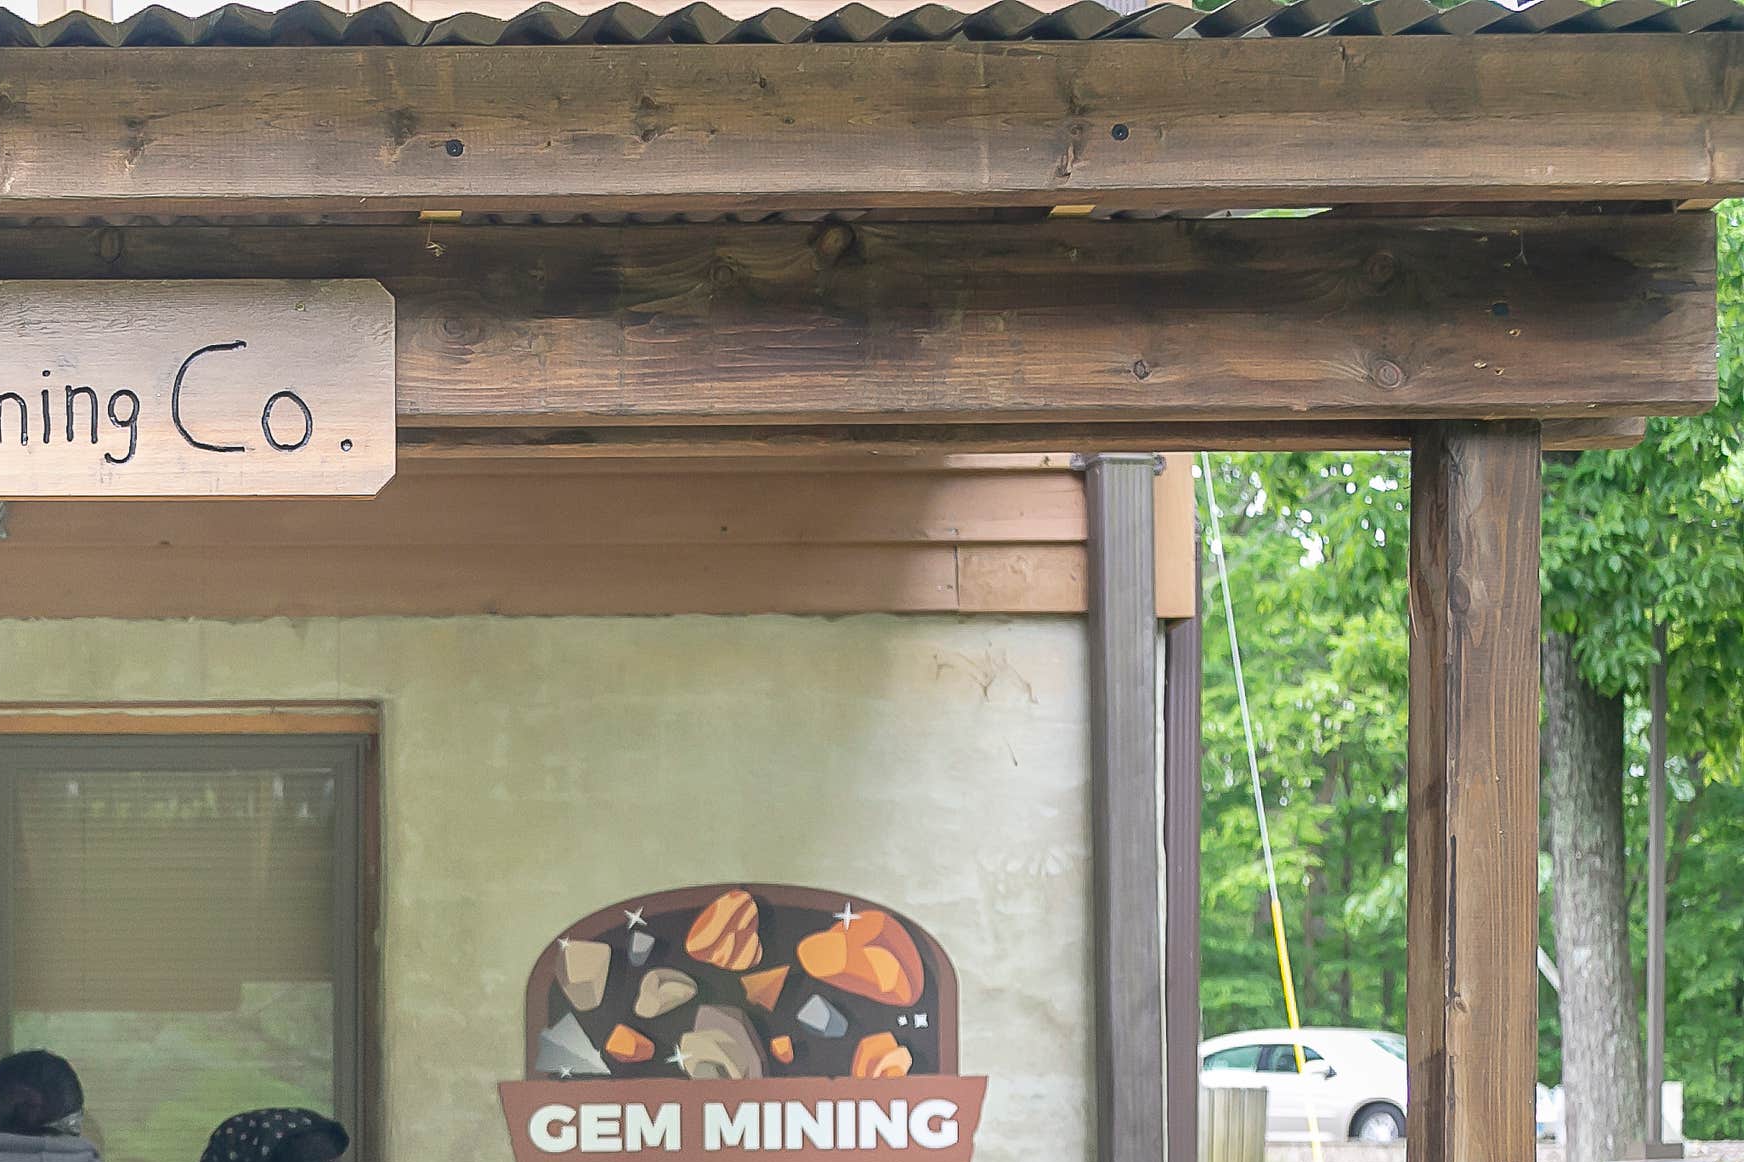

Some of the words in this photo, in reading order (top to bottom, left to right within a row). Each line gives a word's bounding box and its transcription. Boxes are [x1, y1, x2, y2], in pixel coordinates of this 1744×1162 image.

[171, 339, 353, 453] Co.
[529, 1102, 682, 1153] GEM
[704, 1098, 959, 1151] MINING
